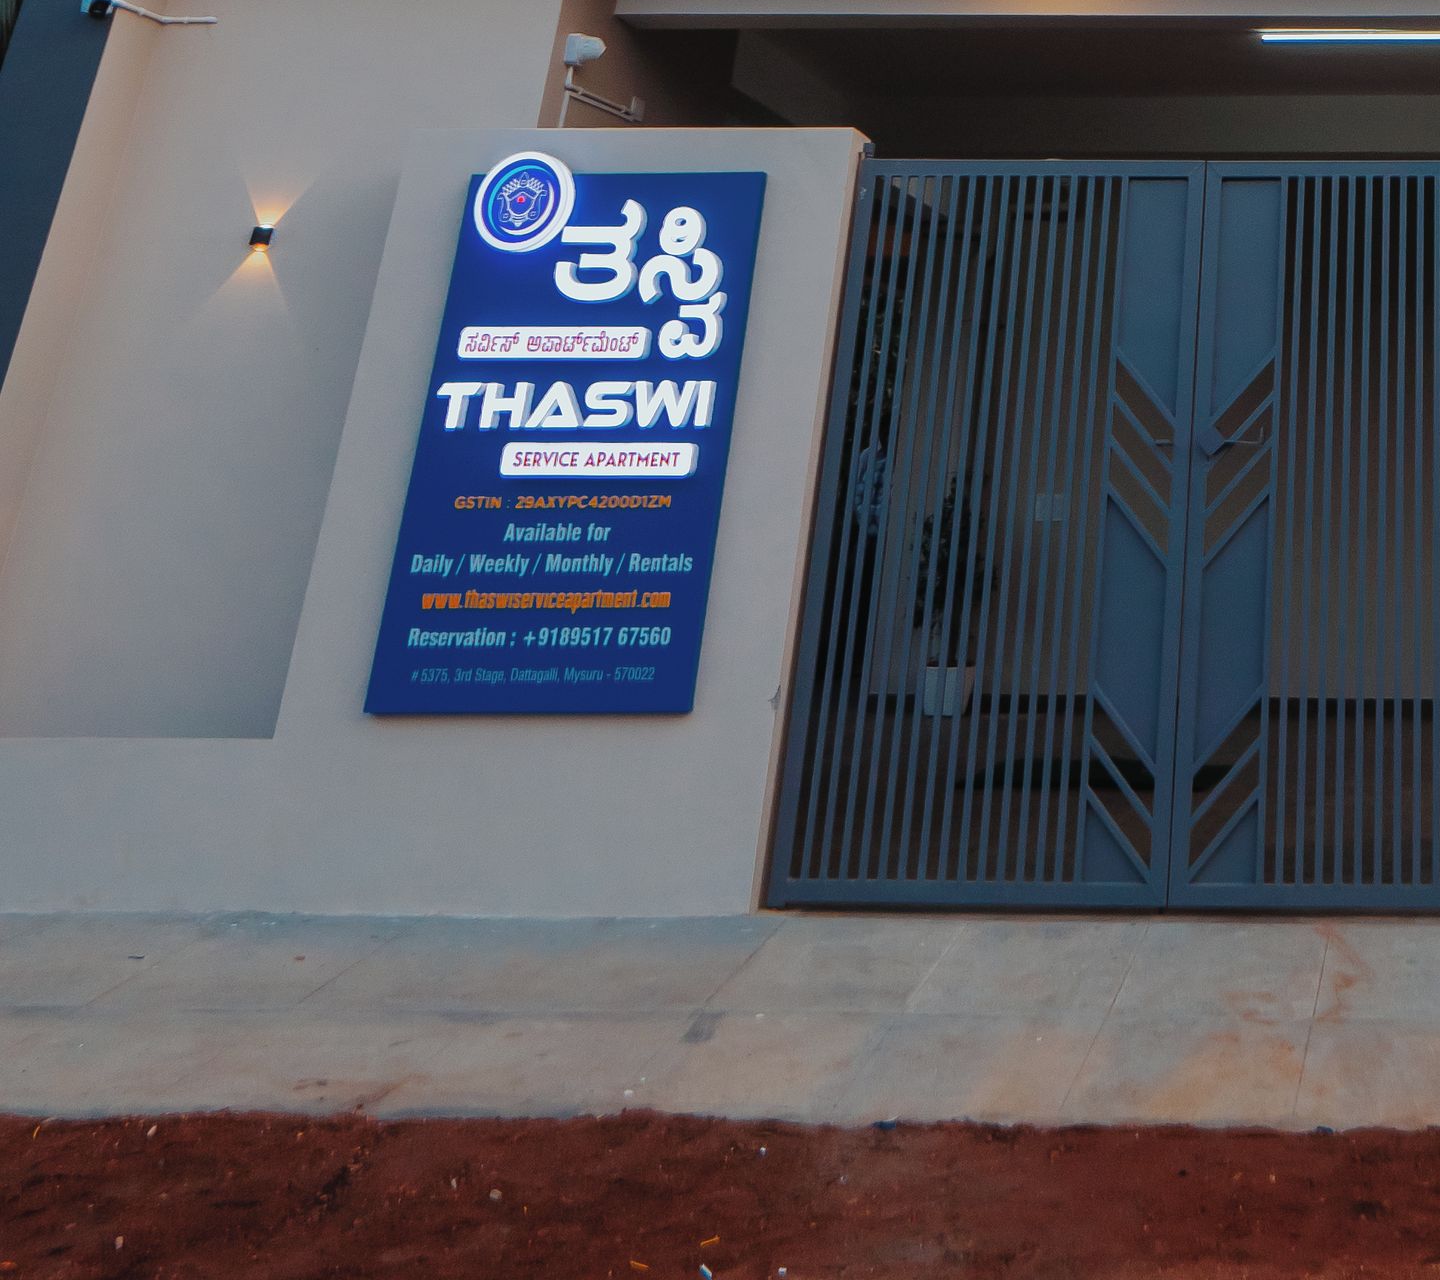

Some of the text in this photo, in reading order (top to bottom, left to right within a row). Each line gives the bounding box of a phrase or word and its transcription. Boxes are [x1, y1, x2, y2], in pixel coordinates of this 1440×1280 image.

[436, 379, 718, 430] THASWI
[512, 451, 681, 468] SERVICE APARTMENT
[454, 495, 502, 510] GSTIN
[503, 522, 612, 542] Available for
[410, 554, 454, 577] Daily
[468, 553, 530, 576] Weekly
[545, 553, 614, 576] Monthly
[628, 552, 694, 573] Rentals
[422, 589, 672, 615] www.thaswiserviceapartment.com
[408, 627, 507, 648] Reservation
[617, 626, 673, 647] 67560
[563, 666, 604, 685] Mysuru
